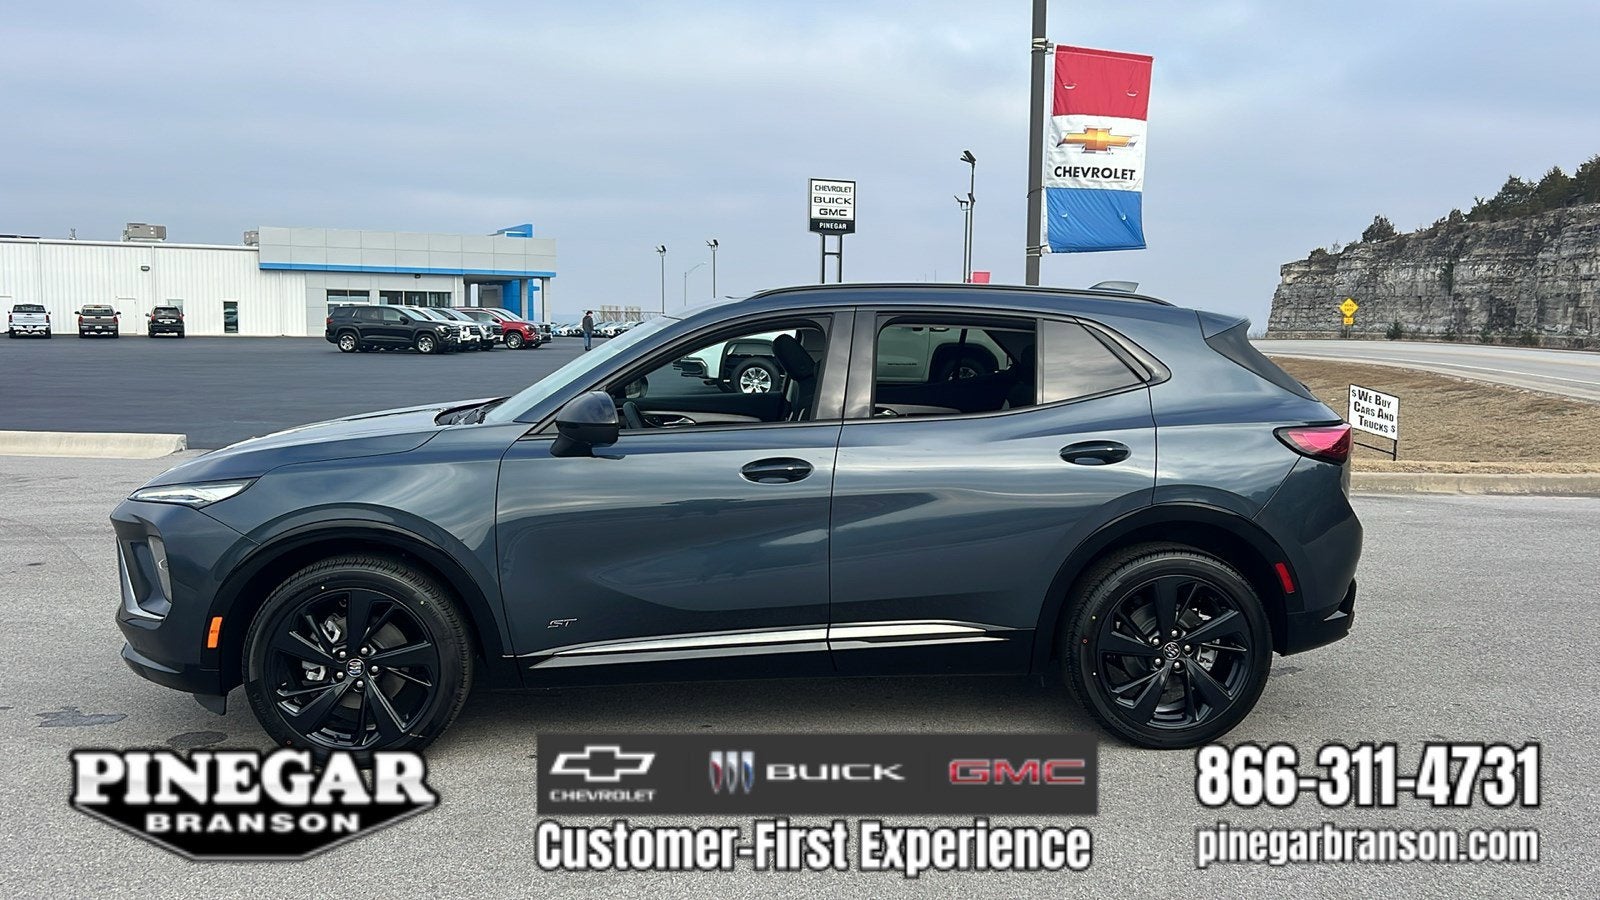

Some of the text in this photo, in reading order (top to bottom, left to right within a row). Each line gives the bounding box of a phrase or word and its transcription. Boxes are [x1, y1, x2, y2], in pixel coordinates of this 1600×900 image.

[1054, 166, 1136, 181] CHEVROLET
[814, 184, 852, 193] CHEVROLET
[813, 196, 852, 205] BUICK
[819, 208, 847, 216] GMC
[819, 222, 847, 230] PINEGAR
[1358, 389, 1372, 403] WE
[1375, 394, 1391, 408] BUY
[1354, 401, 1394, 422] CARS AND
[1358, 414, 1388, 433] TRUCKS
